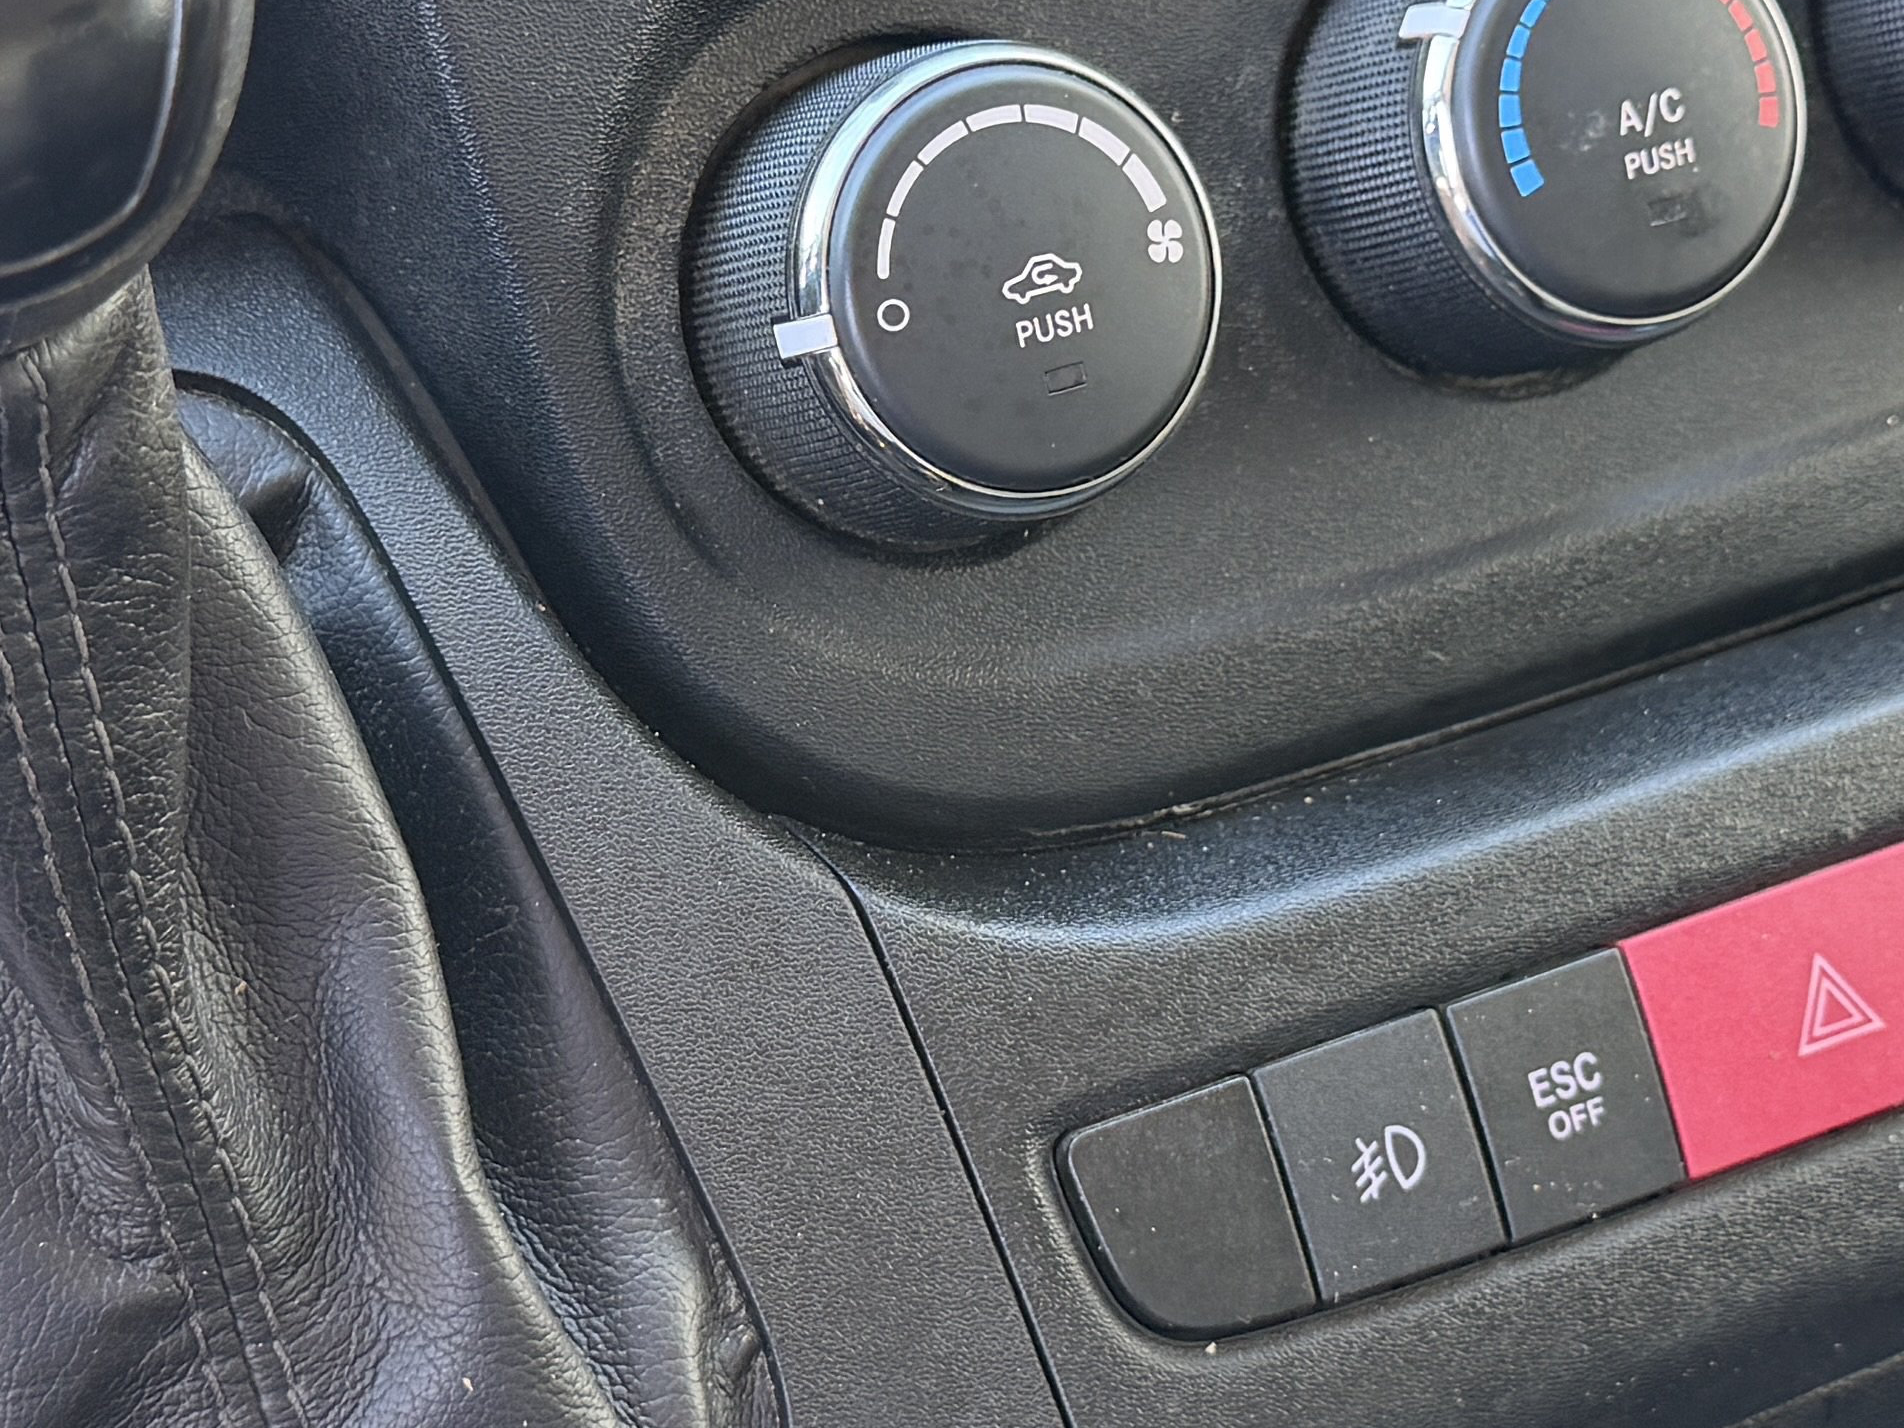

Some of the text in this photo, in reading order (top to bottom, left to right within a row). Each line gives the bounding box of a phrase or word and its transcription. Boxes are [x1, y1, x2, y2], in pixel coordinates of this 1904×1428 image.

[1619, 87, 1686, 137] A/C
[1624, 137, 1696, 180] PUSH
[1014, 302, 1096, 349] PUSH
[1527, 1051, 1604, 1108] ESC
[1547, 1095, 1606, 1140] OFF
